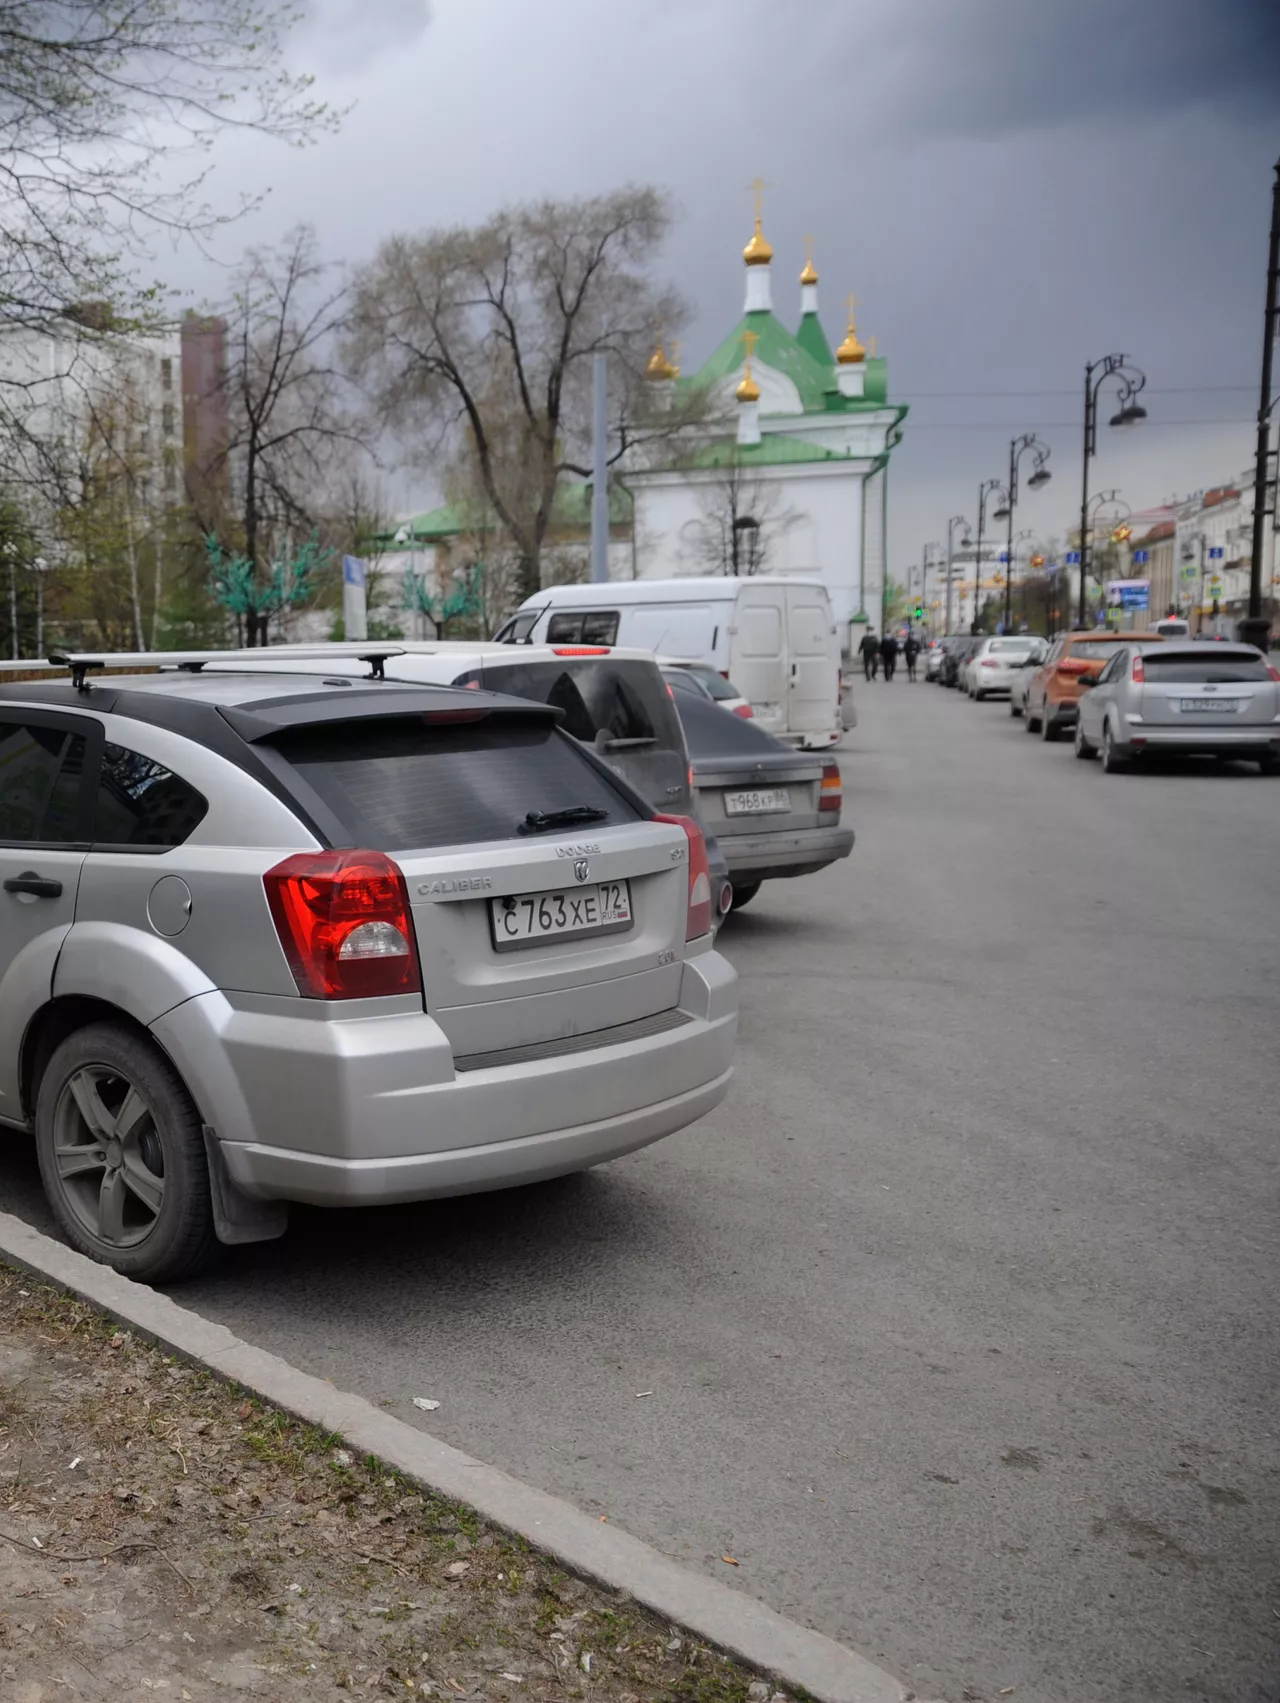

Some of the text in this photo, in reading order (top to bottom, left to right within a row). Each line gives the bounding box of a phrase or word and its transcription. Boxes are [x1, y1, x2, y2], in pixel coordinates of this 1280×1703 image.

[555, 843, 601, 858] DODGE
[417, 876, 493, 896] CALIBER
[601, 885, 622, 911] 72
[601, 910, 617, 921] RUS
